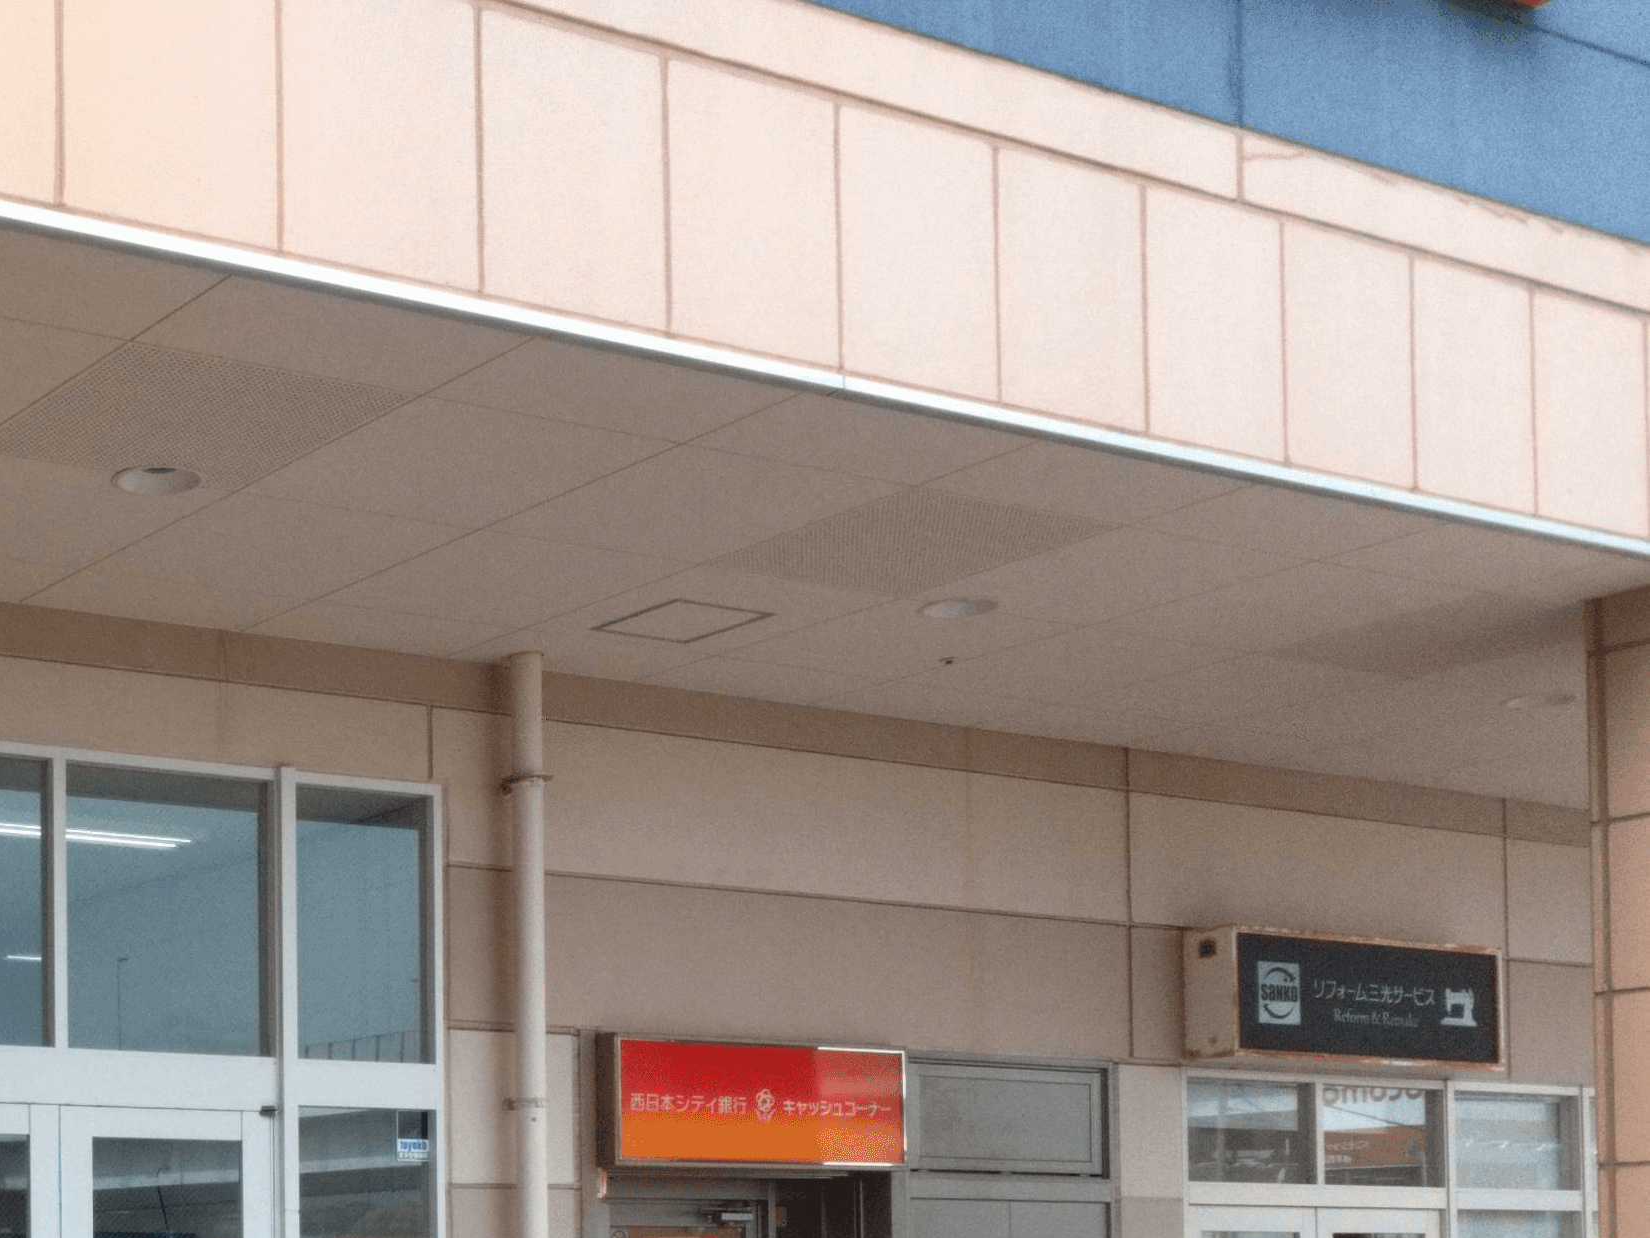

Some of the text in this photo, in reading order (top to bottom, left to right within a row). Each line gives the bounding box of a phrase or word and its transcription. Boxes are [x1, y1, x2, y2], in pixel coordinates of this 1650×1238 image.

[1314, 978, 1435, 1006] リフォーム三光サービス
[631, 1092, 892, 1118] 西日本シティ銀行 キャッシュコーナー
